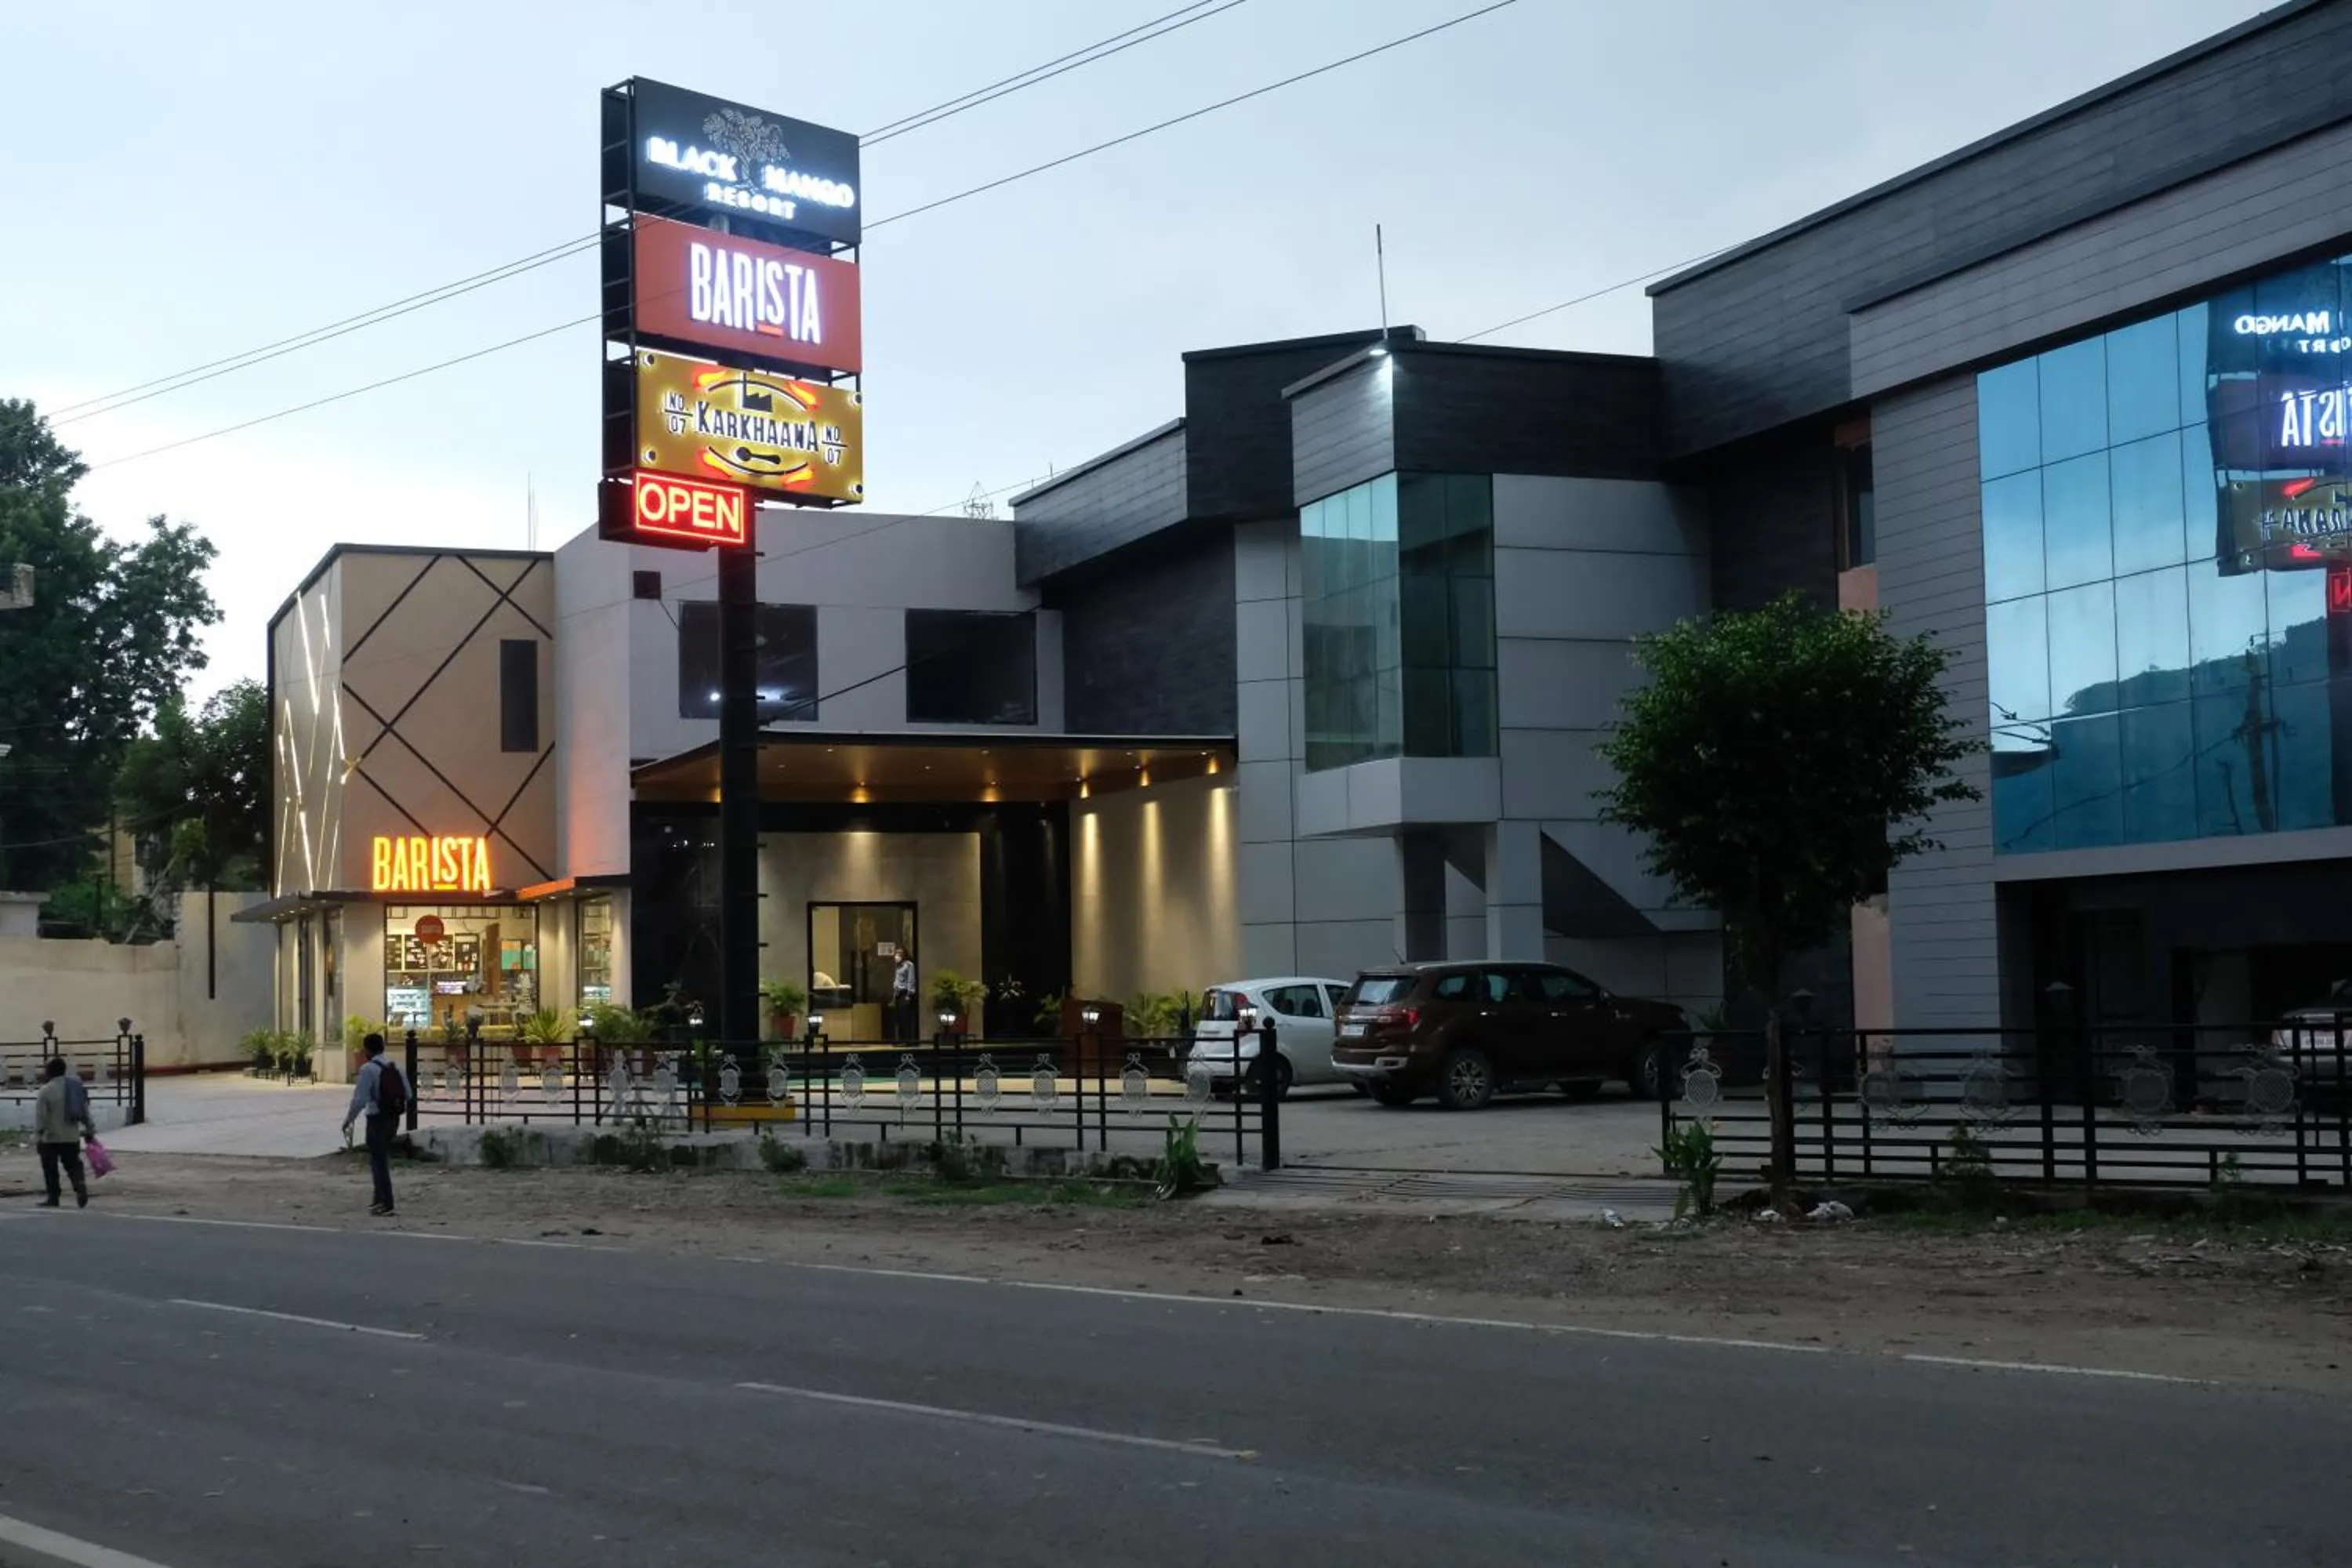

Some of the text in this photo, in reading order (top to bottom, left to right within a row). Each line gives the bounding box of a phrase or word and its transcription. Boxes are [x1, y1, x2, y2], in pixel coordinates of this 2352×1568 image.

[646, 136, 855, 209] BLACK MANGO
[705, 182, 796, 220] RESORT
[690, 242, 821, 344] BARISTA
[670, 415, 687, 434] 07
[696, 401, 818, 452] KARKHAANA
[826, 448, 841, 464] 07
[639, 482, 740, 532] OPEN
[372, 837, 491, 891] BARISTA
